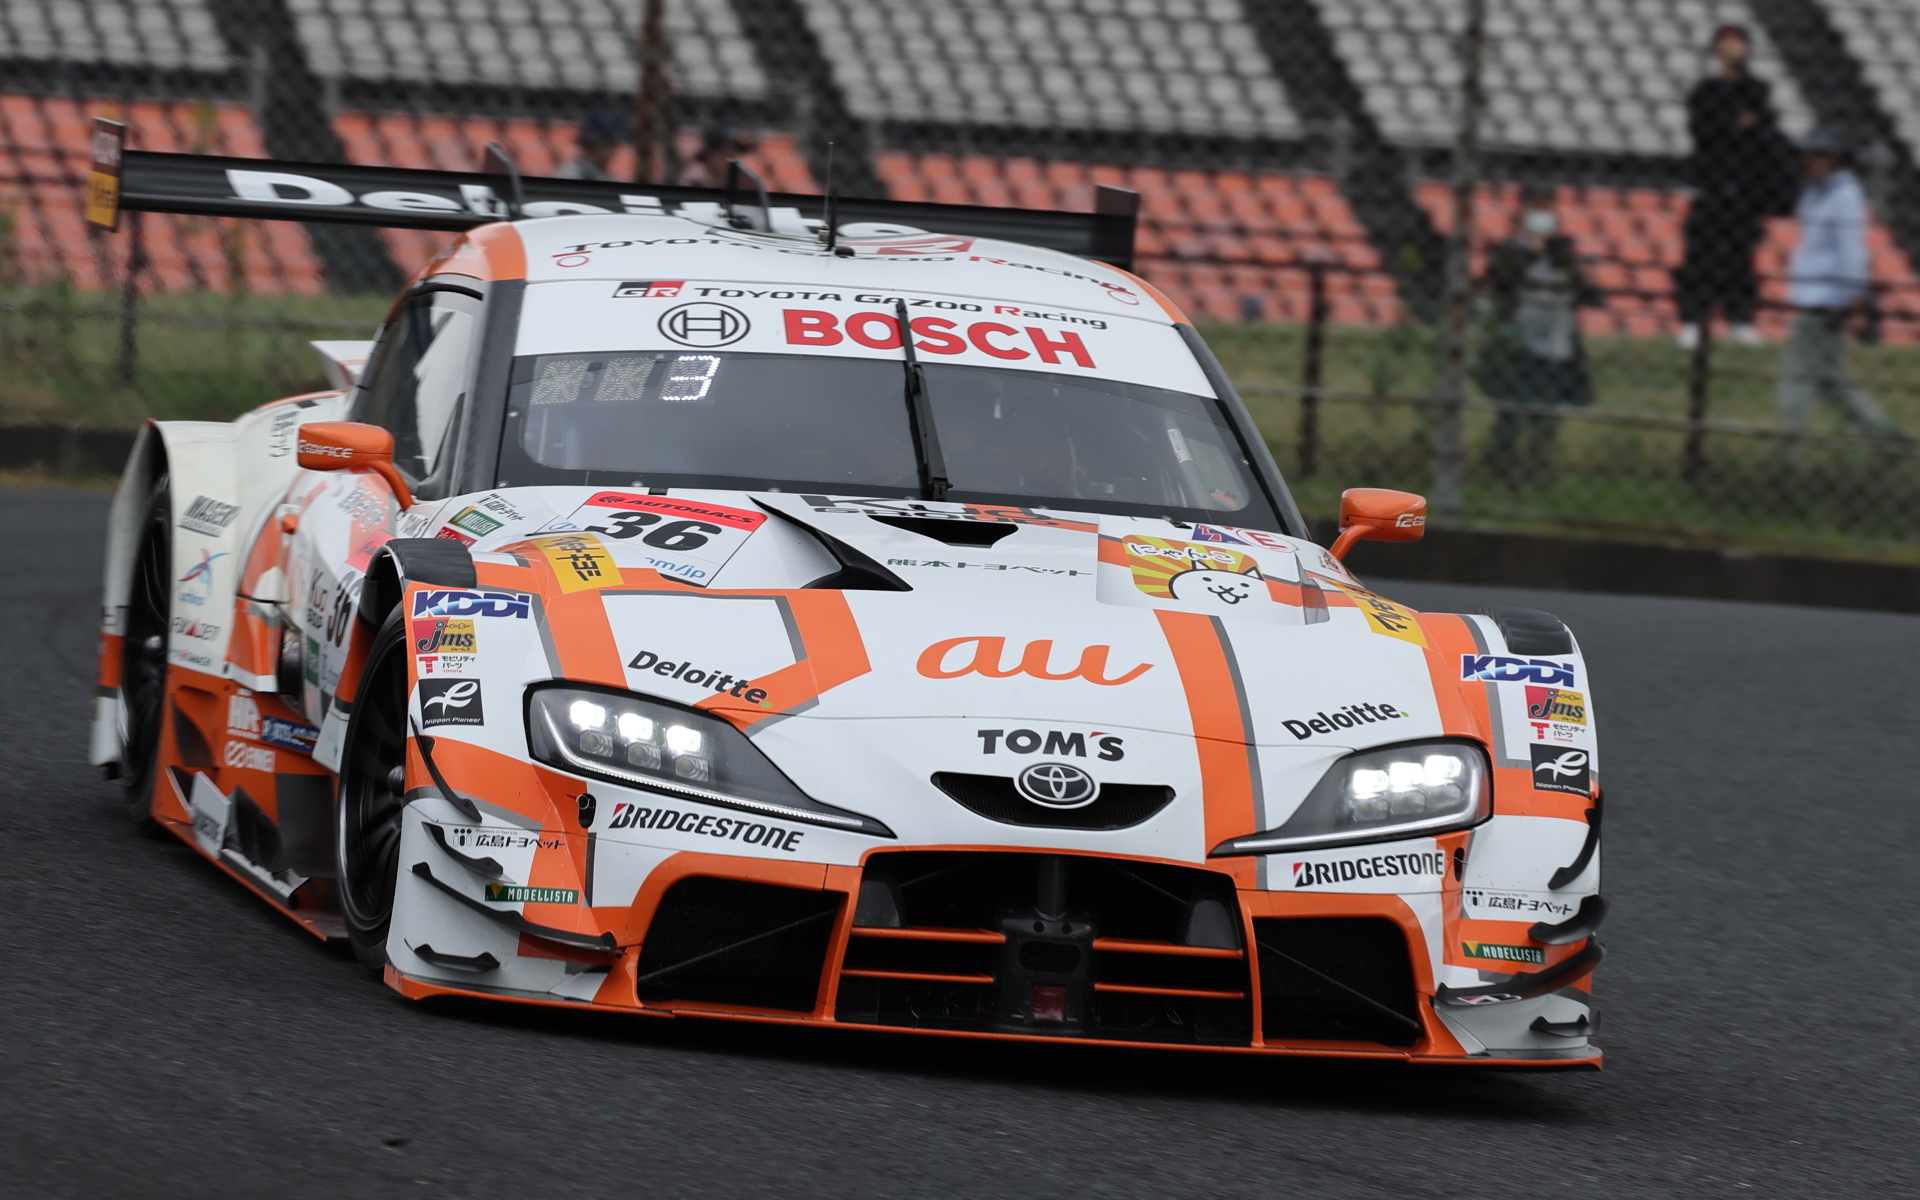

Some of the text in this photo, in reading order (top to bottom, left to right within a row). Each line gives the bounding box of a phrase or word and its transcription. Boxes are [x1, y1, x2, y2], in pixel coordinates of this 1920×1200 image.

[694, 287, 842, 302] TOYOTA
[994, 305, 1108, 330] Racing
[782, 309, 1098, 369] BOSCH
[625, 499, 756, 524] AUTOBACS
[583, 511, 723, 551] 36
[413, 591, 531, 619] KDDI
[417, 620, 475, 653] jms
[916, 636, 1156, 686] au
[1463, 655, 1575, 688] KDDI
[1529, 689, 1585, 719] jms
[424, 718, 451, 726] Nippon
[475, 834, 566, 849] 広島トヨペット
[608, 802, 804, 853] BRIDGESTONE
[1293, 850, 1445, 888] BRIDGESTONE
[507, 888, 574, 903] MODELLISTA
[1488, 897, 1573, 915] 広島トヨペット
[1482, 945, 1542, 963] MODELLISTA
